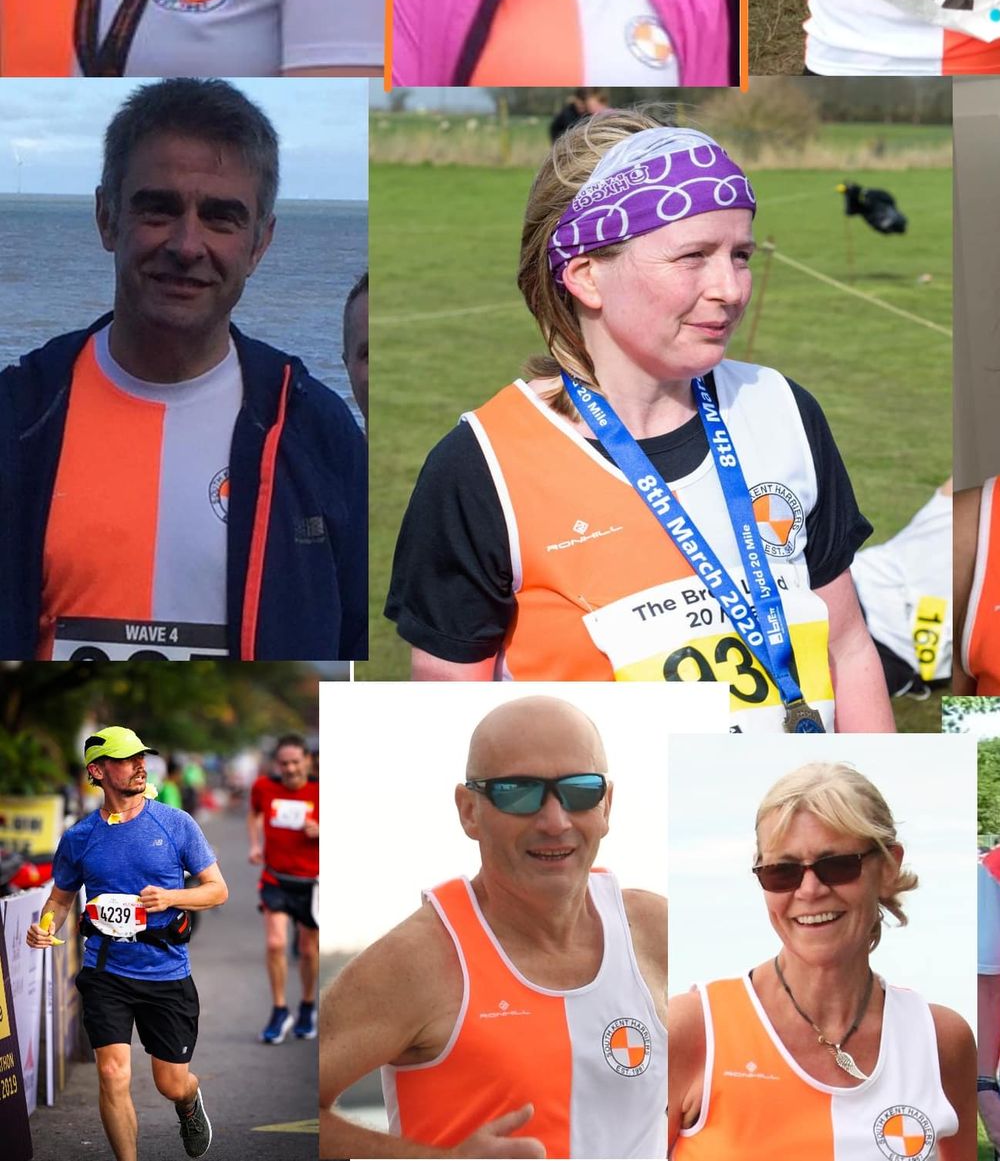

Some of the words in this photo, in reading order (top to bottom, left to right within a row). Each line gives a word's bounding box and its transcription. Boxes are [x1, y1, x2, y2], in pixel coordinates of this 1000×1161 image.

[577, 387, 592, 403] 20
[587, 402, 608, 428] Mile
[696, 376, 721, 423] Mar
[712, 430, 737, 468] 8th
[775, 486, 802, 531] HARRIERS
[546, 525, 624, 552] RONHILL
[742, 524, 756, 550] Mile
[637, 475, 670, 516] 8th
[666, 515, 724, 590] March
[717, 591, 764, 646] 2020
[748, 551, 759, 567] 20
[753, 569, 771, 598] Lydd
[632, 597, 683, 622] The
[685, 607, 713, 628] 20
[125, 624, 167, 642] WAVE
[169, 626, 179, 643] 4
[100, 906, 131, 924] 4239
[611, 1019, 629, 1031] KENT
[1, 1074, 18, 1100] 2019
[874, 1117, 886, 1145] SOUTH
[885, 1106, 906, 1119] KENT
[908, 1107, 933, 1146] HARRIERS
